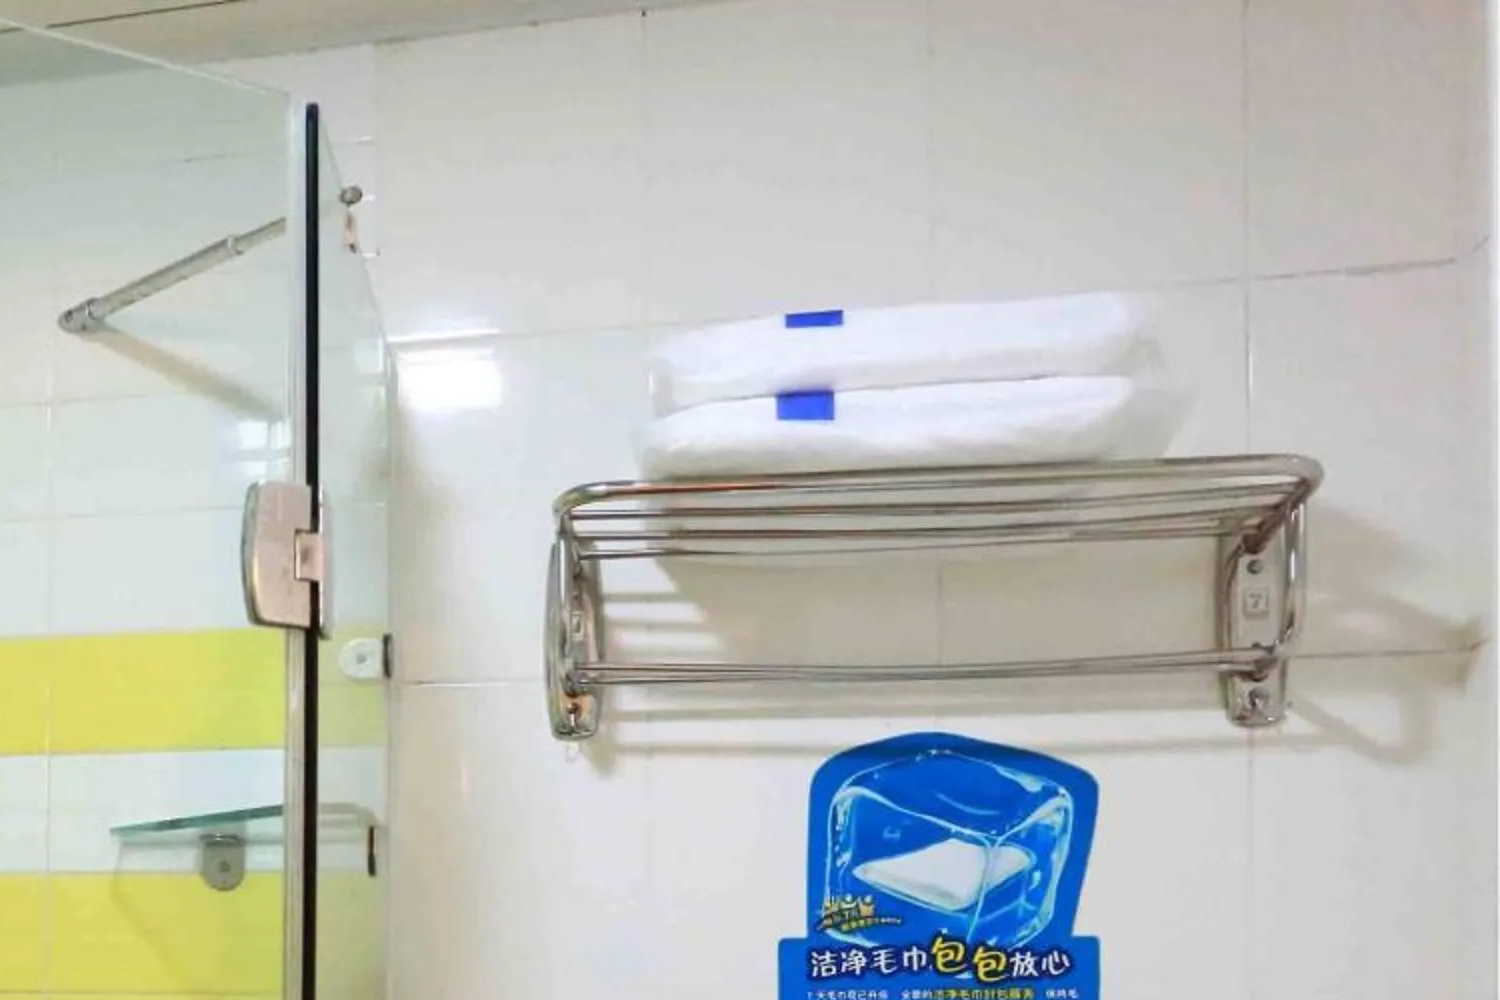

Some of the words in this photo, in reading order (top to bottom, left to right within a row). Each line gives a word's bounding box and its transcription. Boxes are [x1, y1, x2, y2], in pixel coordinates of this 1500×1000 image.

[810, 936, 1071, 982] 洁净毛巾包包放心
